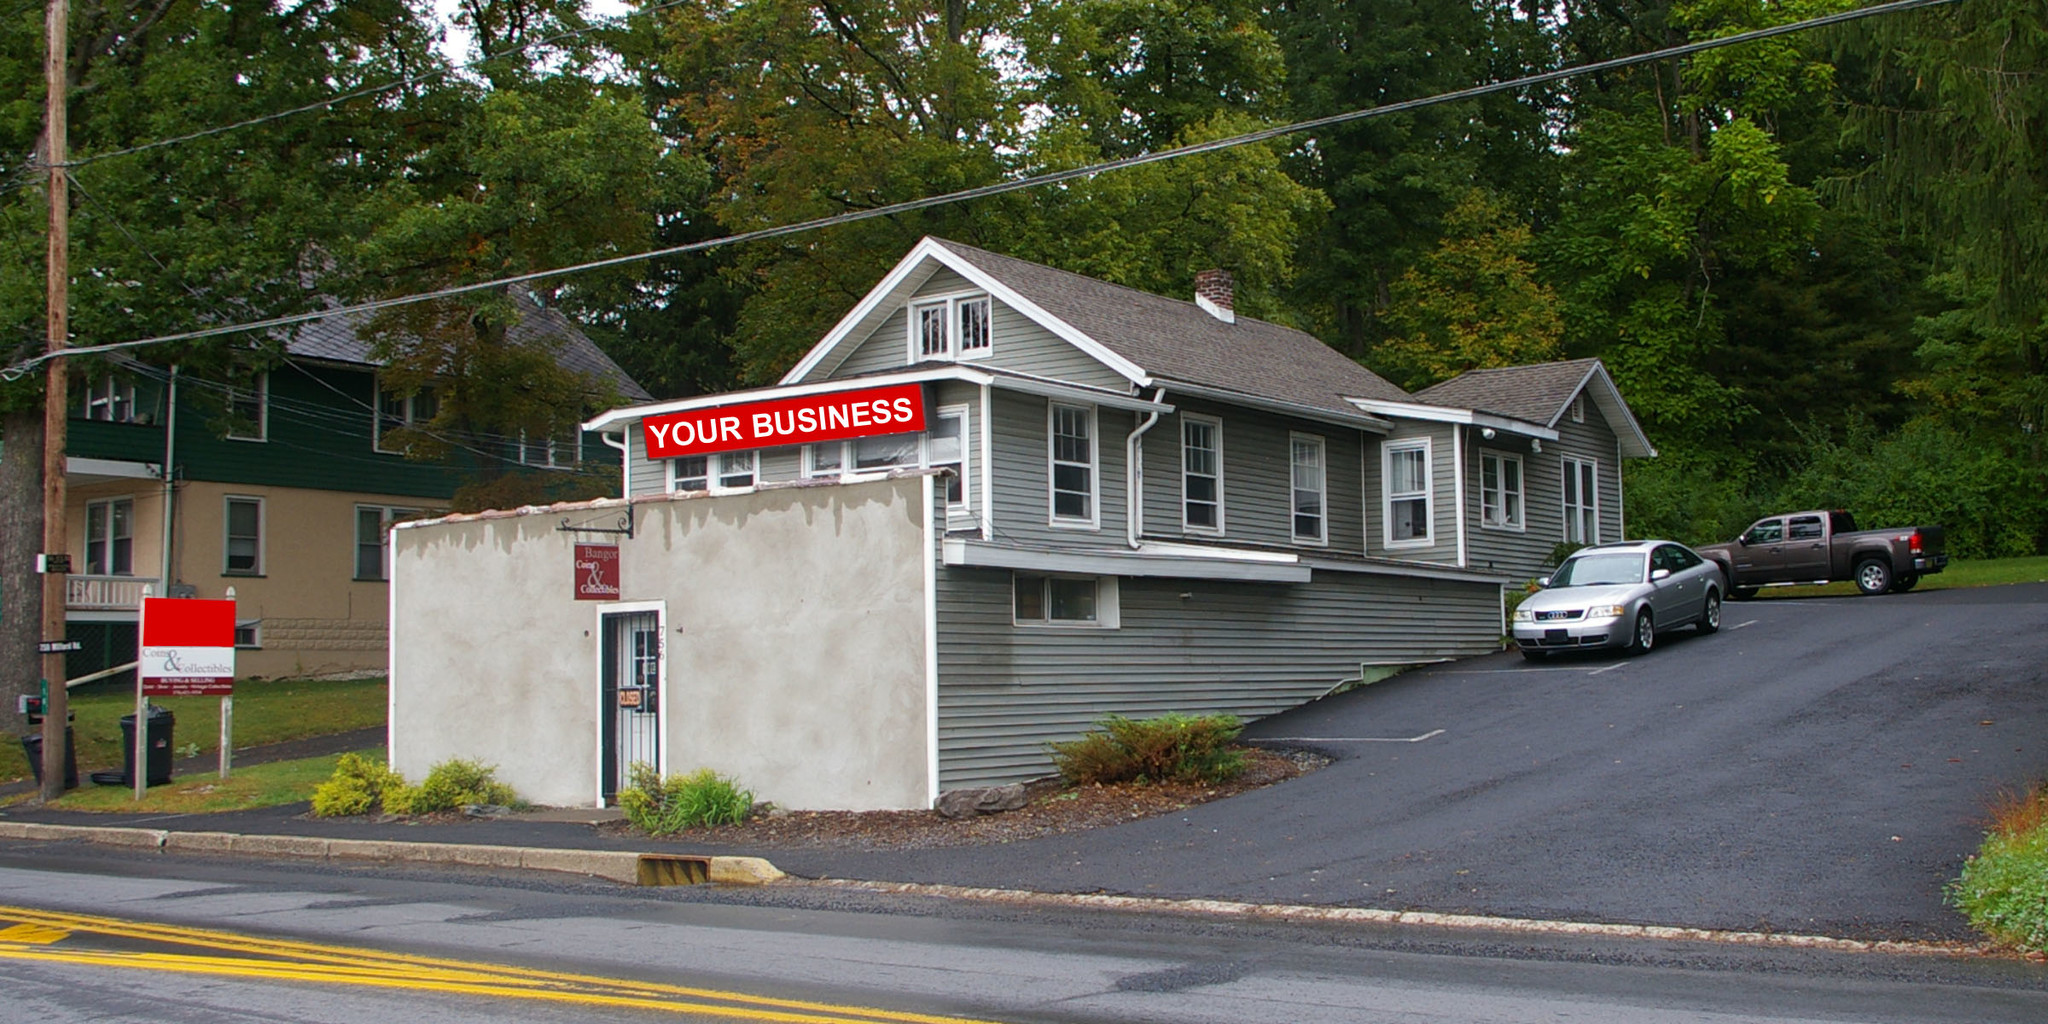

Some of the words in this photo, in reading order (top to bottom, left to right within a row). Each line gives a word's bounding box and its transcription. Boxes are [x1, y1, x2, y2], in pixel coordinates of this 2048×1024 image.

[648, 416, 743, 449] YOUR
[752, 398, 914, 439] BUSINESS
[585, 547, 618, 561] Bangor
[164, 649, 181, 672] &
[179, 663, 232, 673] Collectibles
[620, 690, 640, 705] CLOSED
